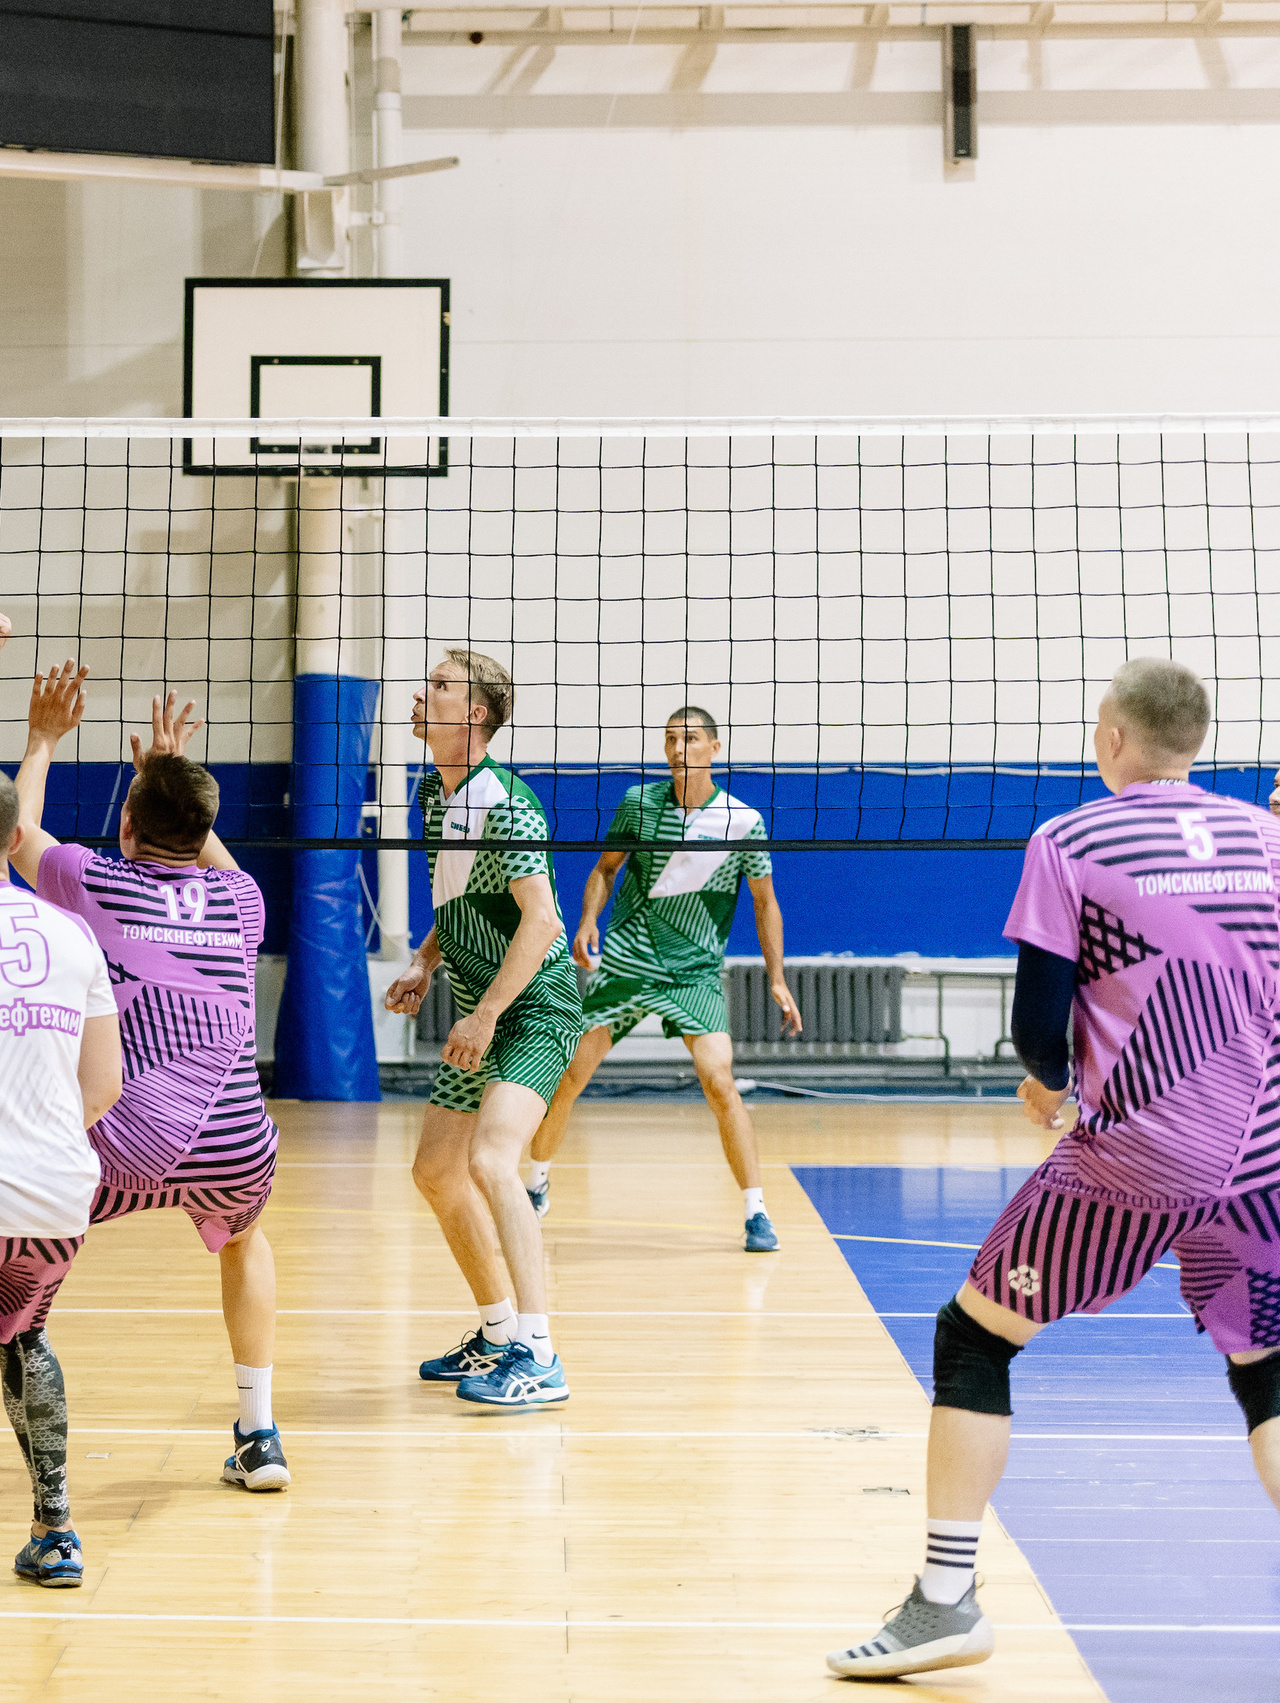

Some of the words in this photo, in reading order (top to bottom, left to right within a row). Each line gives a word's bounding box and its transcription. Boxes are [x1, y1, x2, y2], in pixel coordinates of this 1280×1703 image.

[1177, 811, 1214, 861] 5
[1135, 872, 1273, 896] ТОМСКНЕФТЕХИМ
[160, 881, 206, 923] 19
[122, 924, 243, 948] ТОМСКНЕФТЕХИМ
